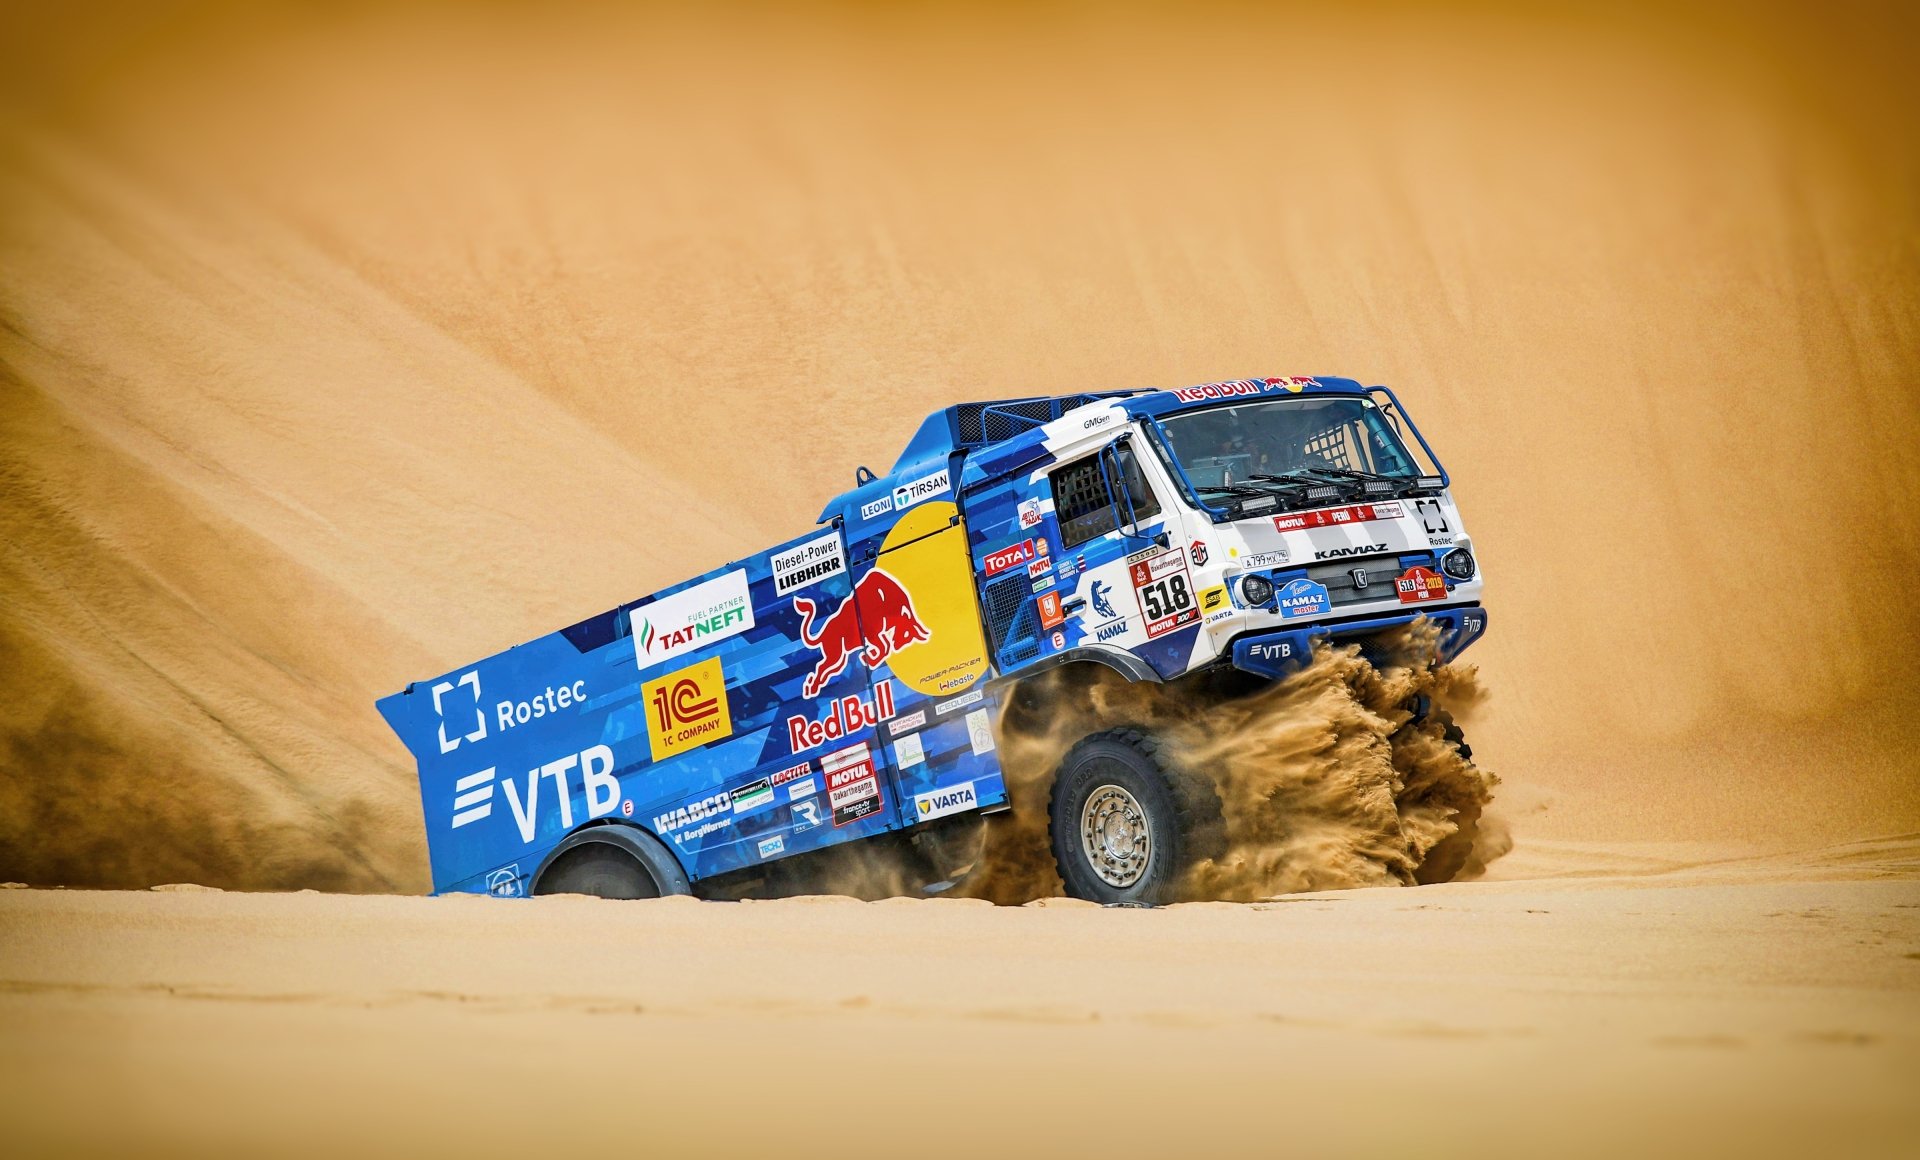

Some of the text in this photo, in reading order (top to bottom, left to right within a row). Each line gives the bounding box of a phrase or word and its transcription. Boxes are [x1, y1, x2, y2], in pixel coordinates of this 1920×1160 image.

[863, 498, 891, 518] LEONI
[1278, 517, 1306, 529] MOTUL
[1314, 543, 1389, 560] KAMAZ
[1429, 536, 1453, 546] Rostec
[774, 539, 838, 573] Diesel-Power
[986, 549, 1034, 571] TOTAL
[778, 557, 841, 590] LIEBHERR
[1399, 576, 1443, 592] 518 2019
[687, 595, 744, 623] FUEL PARTNER
[1142, 575, 1191, 621] 518
[1282, 594, 1325, 608] KAMAZ
[1211, 610, 1234, 622] VARTA
[1293, 605, 1320, 615] master
[659, 605, 746, 651] TATNEFT
[1096, 621, 1129, 643] KAMAZ
[1150, 618, 1176, 635] MOTUL
[1263, 643, 1291, 660] VTB
[939, 672, 976, 691] Webasto
[496, 680, 588, 732] Rostec
[788, 699, 844, 755] Red
[842, 680, 896, 737] Bull
[677, 718, 720, 742] COMPANY
[772, 763, 811, 786] LOCTITE
[831, 764, 869, 788] MOTUL
[501, 744, 622, 844] VTB
[833, 780, 872, 801] Dakarthegame
[932, 789, 974, 810] VARTA
[652, 791, 733, 835] WABCO
[684, 818, 731, 841] BorgWarner
